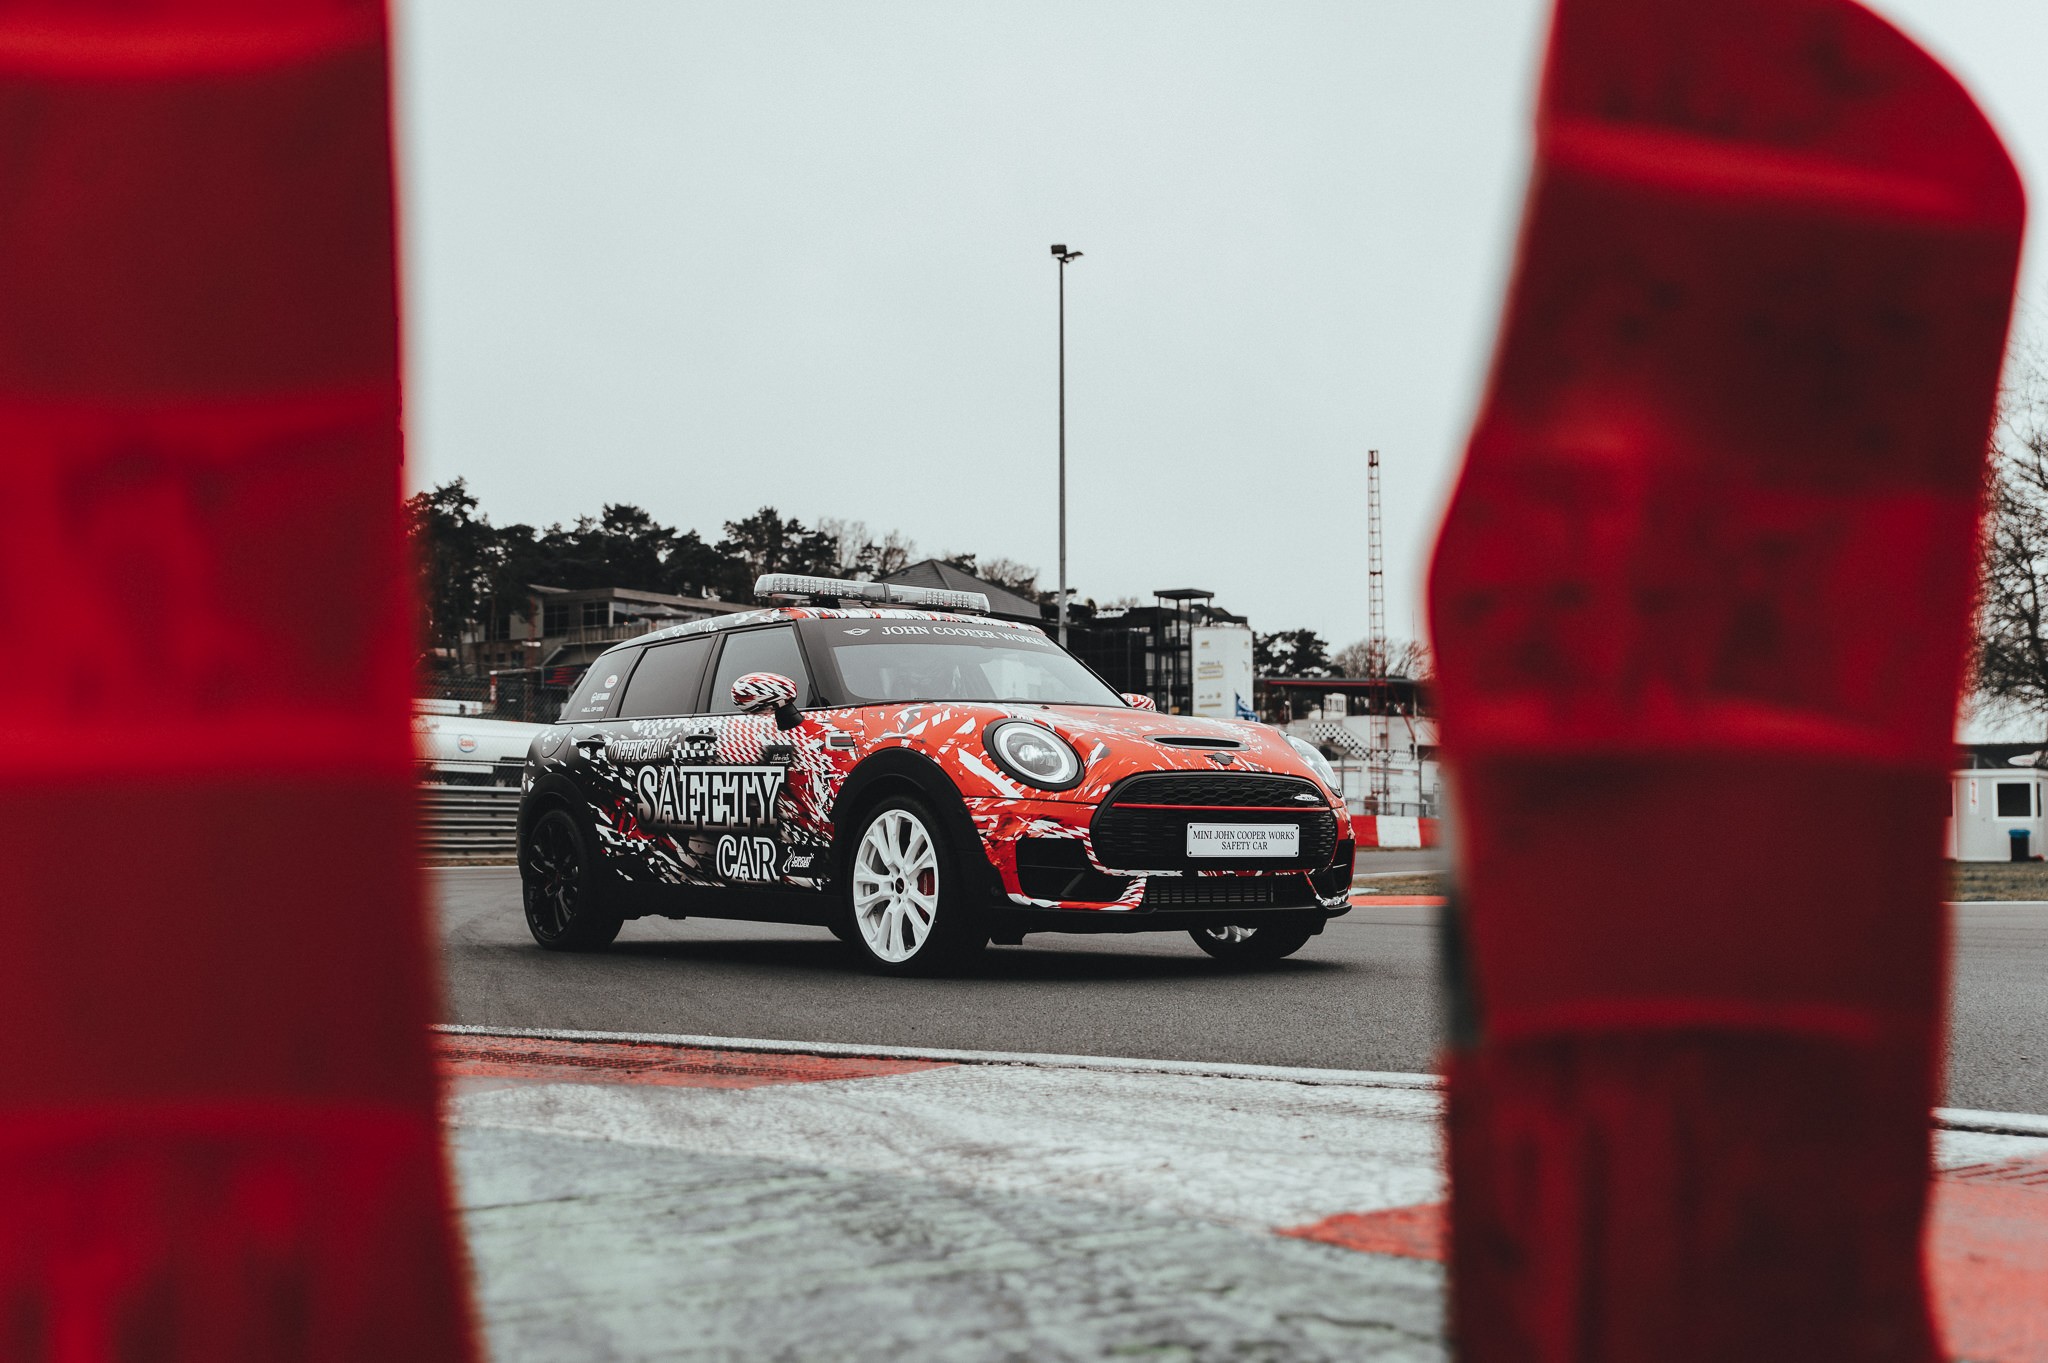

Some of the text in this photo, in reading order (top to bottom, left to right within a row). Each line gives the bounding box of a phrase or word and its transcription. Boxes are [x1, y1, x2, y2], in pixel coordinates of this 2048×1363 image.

[881, 626, 1049, 647] JOHN COOPER WORKS
[609, 738, 670, 763] OFFICIAL
[637, 765, 785, 830] SAFETY
[1192, 831, 1295, 840] MINI JOHN COOPER WORKS
[1221, 841, 1268, 850] SAFETY CAR
[716, 834, 781, 884] CAR
